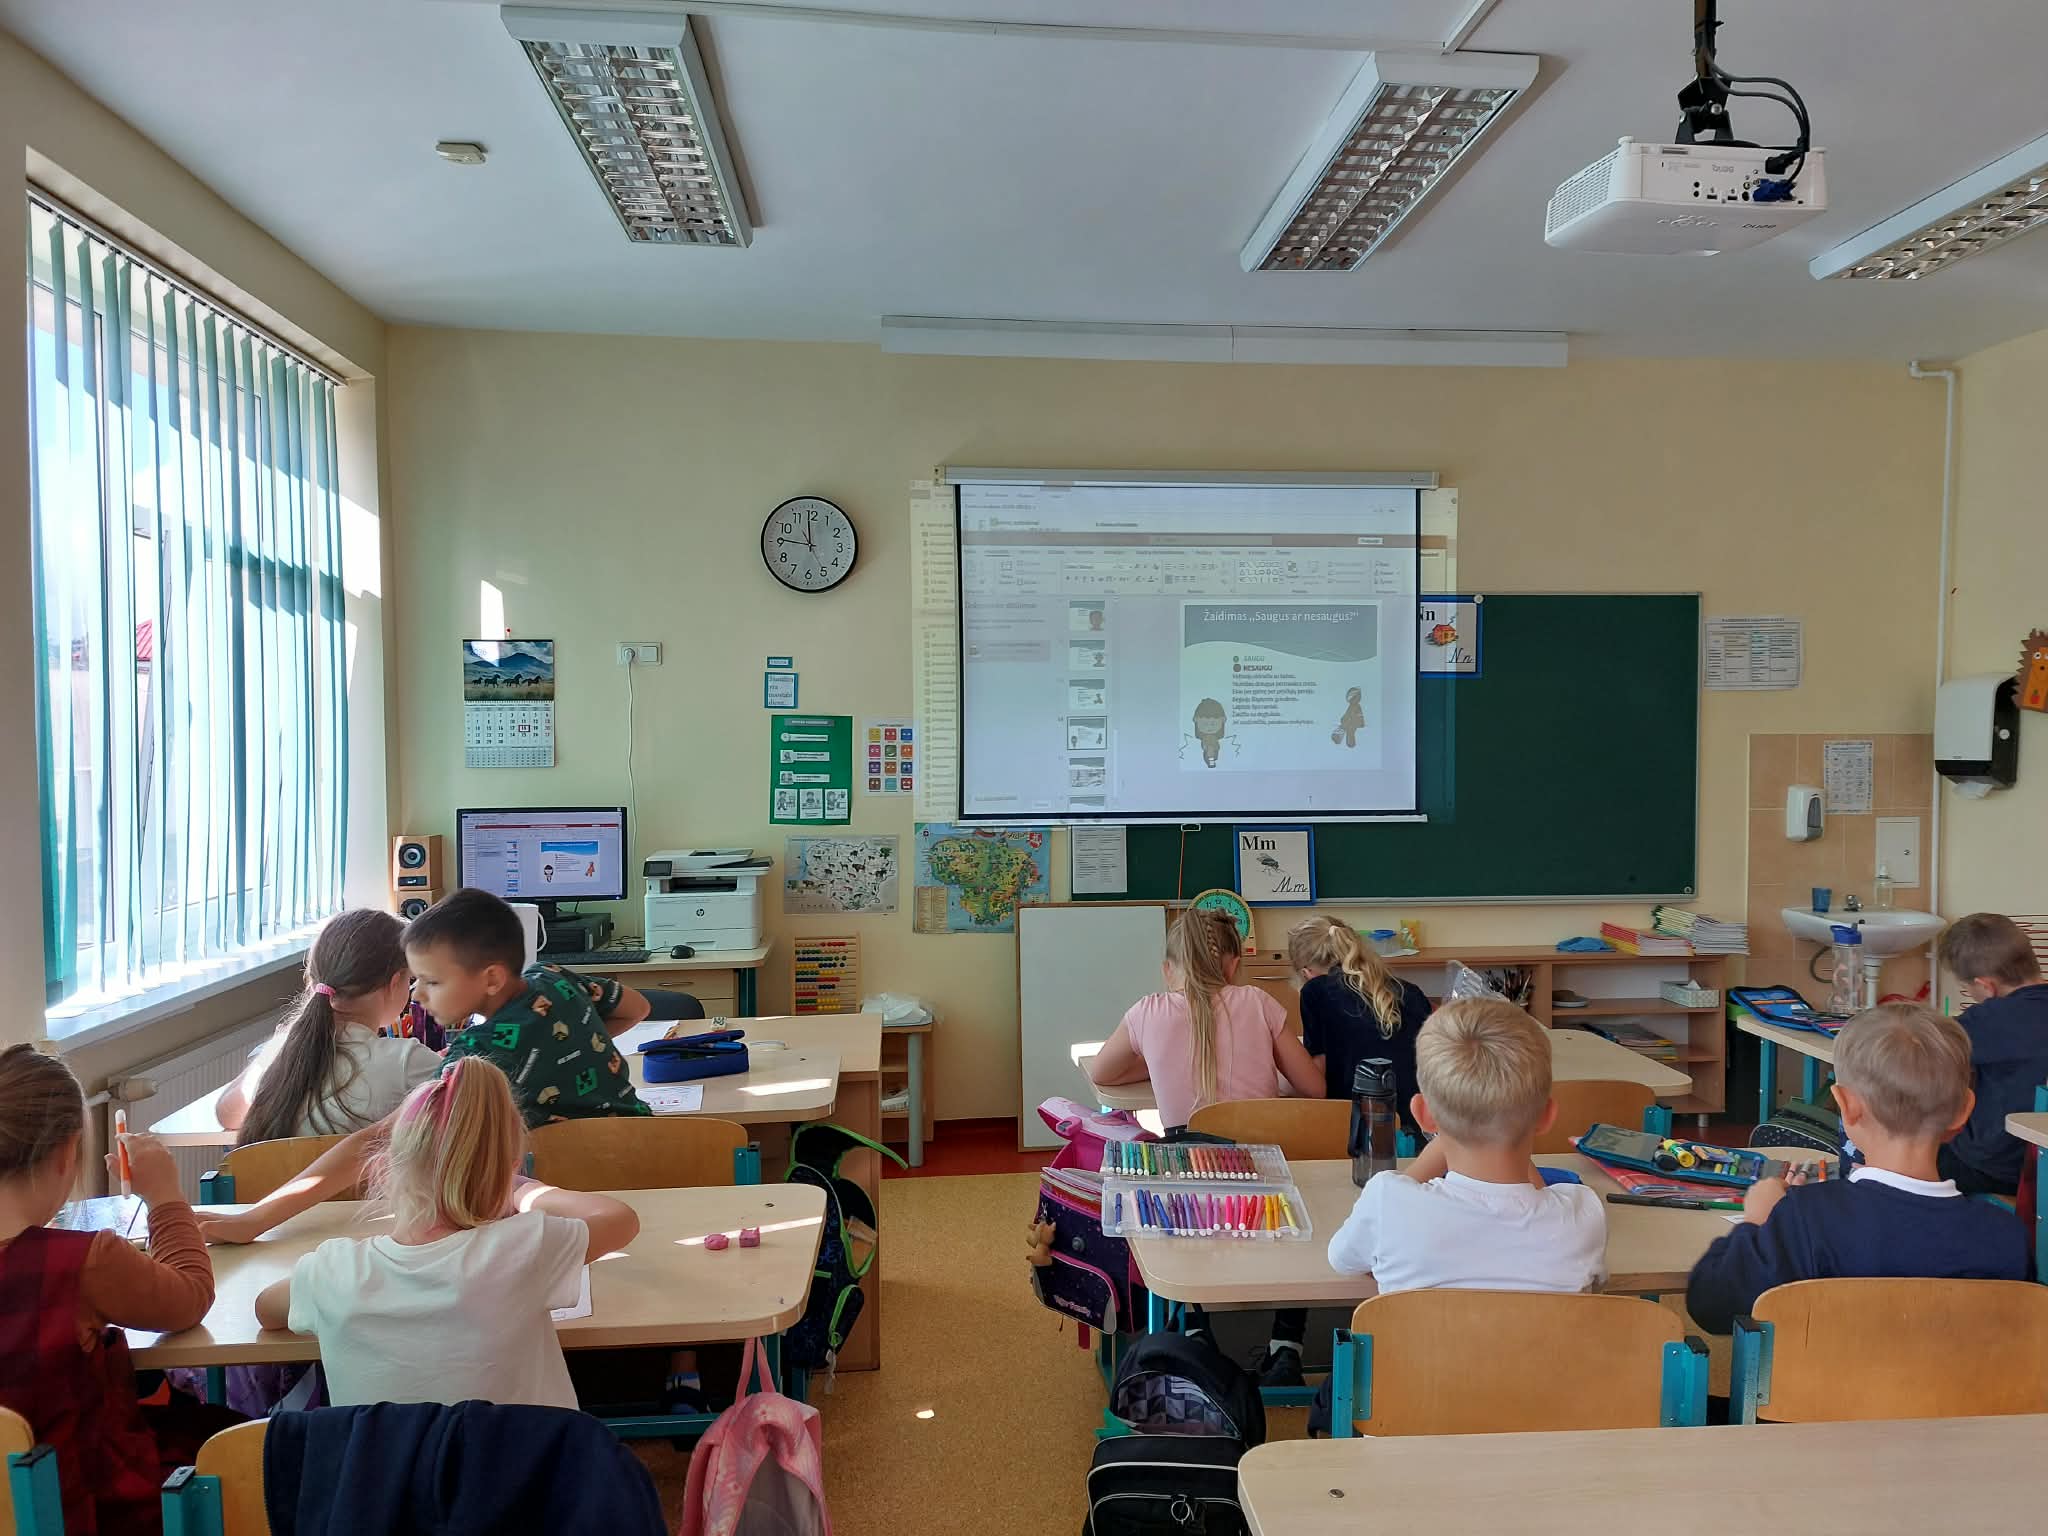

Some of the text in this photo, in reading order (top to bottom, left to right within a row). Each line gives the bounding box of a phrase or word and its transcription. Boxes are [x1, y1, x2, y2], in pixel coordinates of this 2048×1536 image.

[793, 513, 802, 524] 11
[806, 510, 818, 521] 12
[825, 516, 829, 526] 1
[780, 523, 792, 534] 10
[833, 528, 840, 538] 2
[777, 537, 784, 548] 9
[836, 542, 844, 553] 3
[780, 552, 787, 562] 8
[832, 557, 838, 567] 4
[791, 564, 797, 574] 7
[805, 569, 812, 579] 6
[820, 566, 828, 577] 5
[1203, 609, 1248, 621] Žaidimas
[1292, 612, 1300, 621] ar
[1241, 835, 1276, 850] Mm
[1272, 876, 1308, 892] Mm
